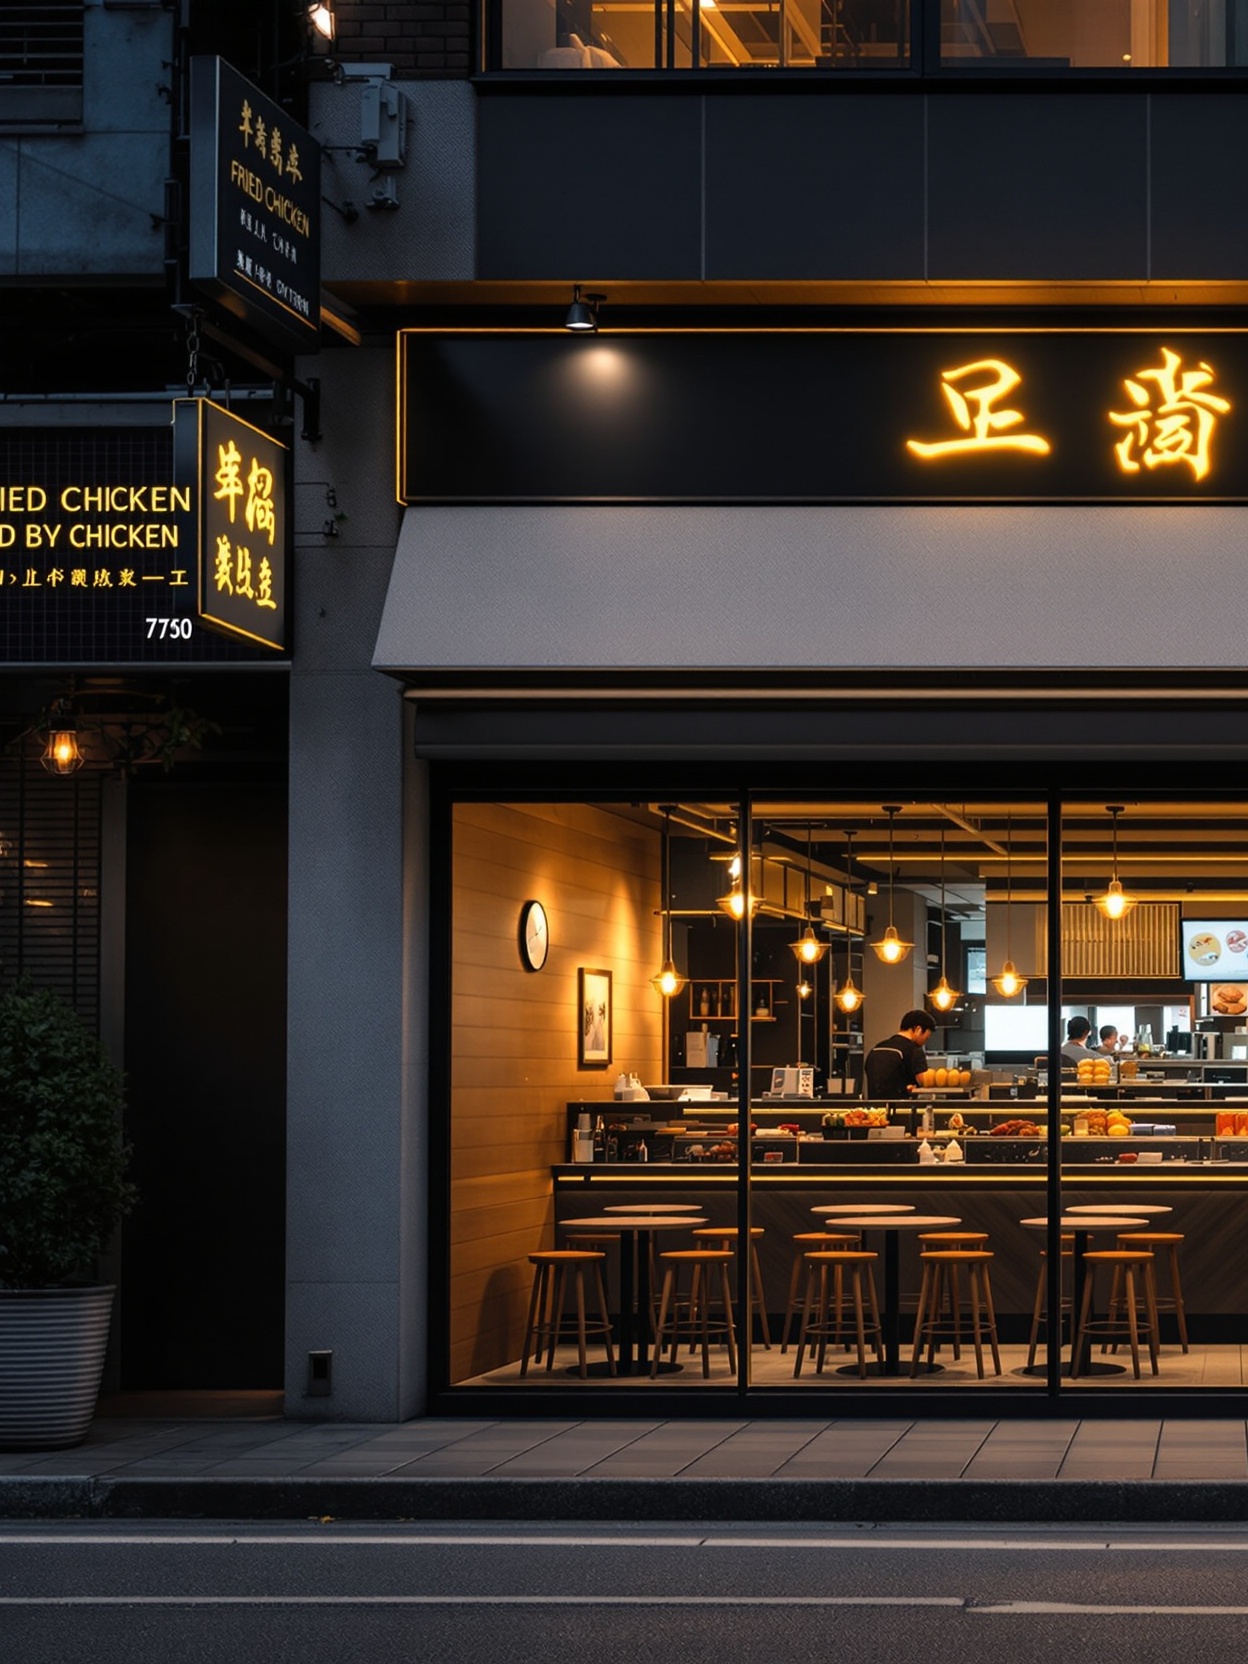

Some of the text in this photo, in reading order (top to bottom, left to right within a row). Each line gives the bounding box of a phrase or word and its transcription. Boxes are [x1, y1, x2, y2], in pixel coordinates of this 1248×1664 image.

[231, 159, 263, 203] FRIED
[265, 186, 310, 239] CHICKEN
[0, 486, 191, 512] IED CHICKEN
[26, 523, 62, 548] BY
[69, 523, 179, 549] CHICKEN
[145, 617, 193, 640] 7750
